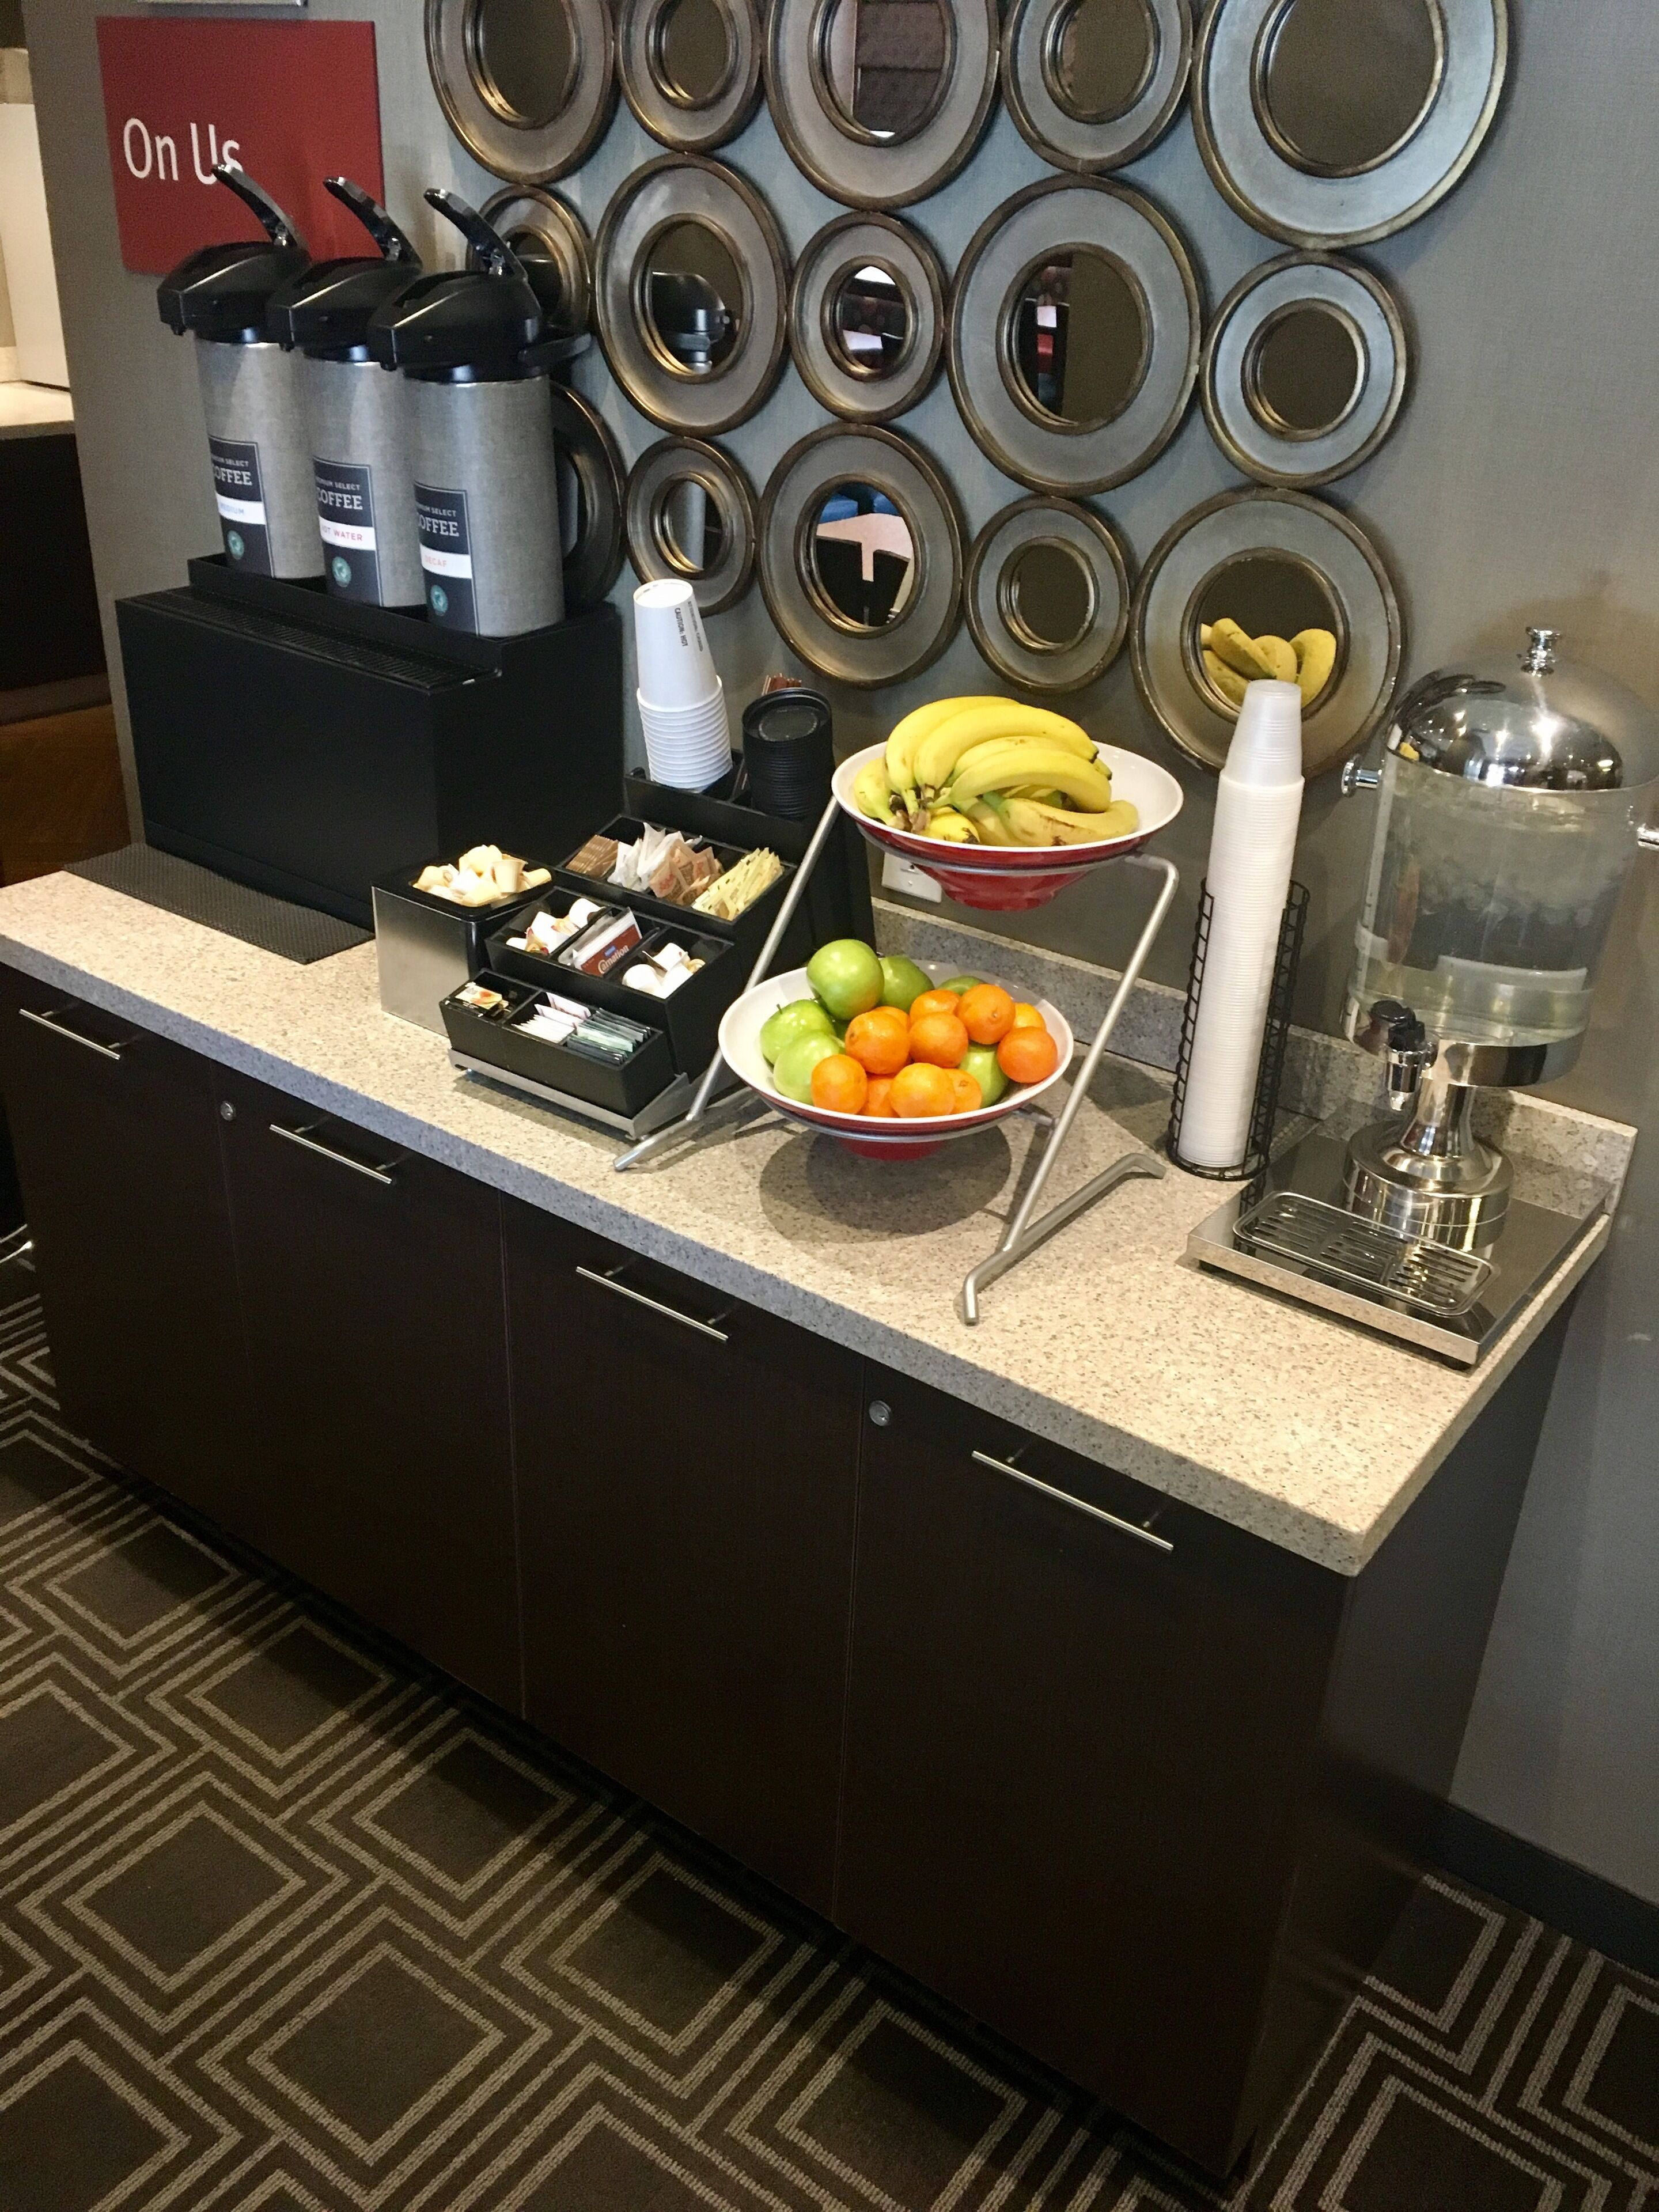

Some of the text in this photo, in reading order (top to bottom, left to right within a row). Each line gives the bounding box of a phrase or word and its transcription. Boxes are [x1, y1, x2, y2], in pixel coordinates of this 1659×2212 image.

[123, 117, 244, 185] On Us
[334, 482, 361, 491] SELECT
[431, 506, 457, 517] SELECT
[334, 529, 363, 541] WATER
[424, 555, 447, 567] DECAF
[675, 607, 688, 646] CAUTION: HOT
[598, 945, 630, 974] Carnation
